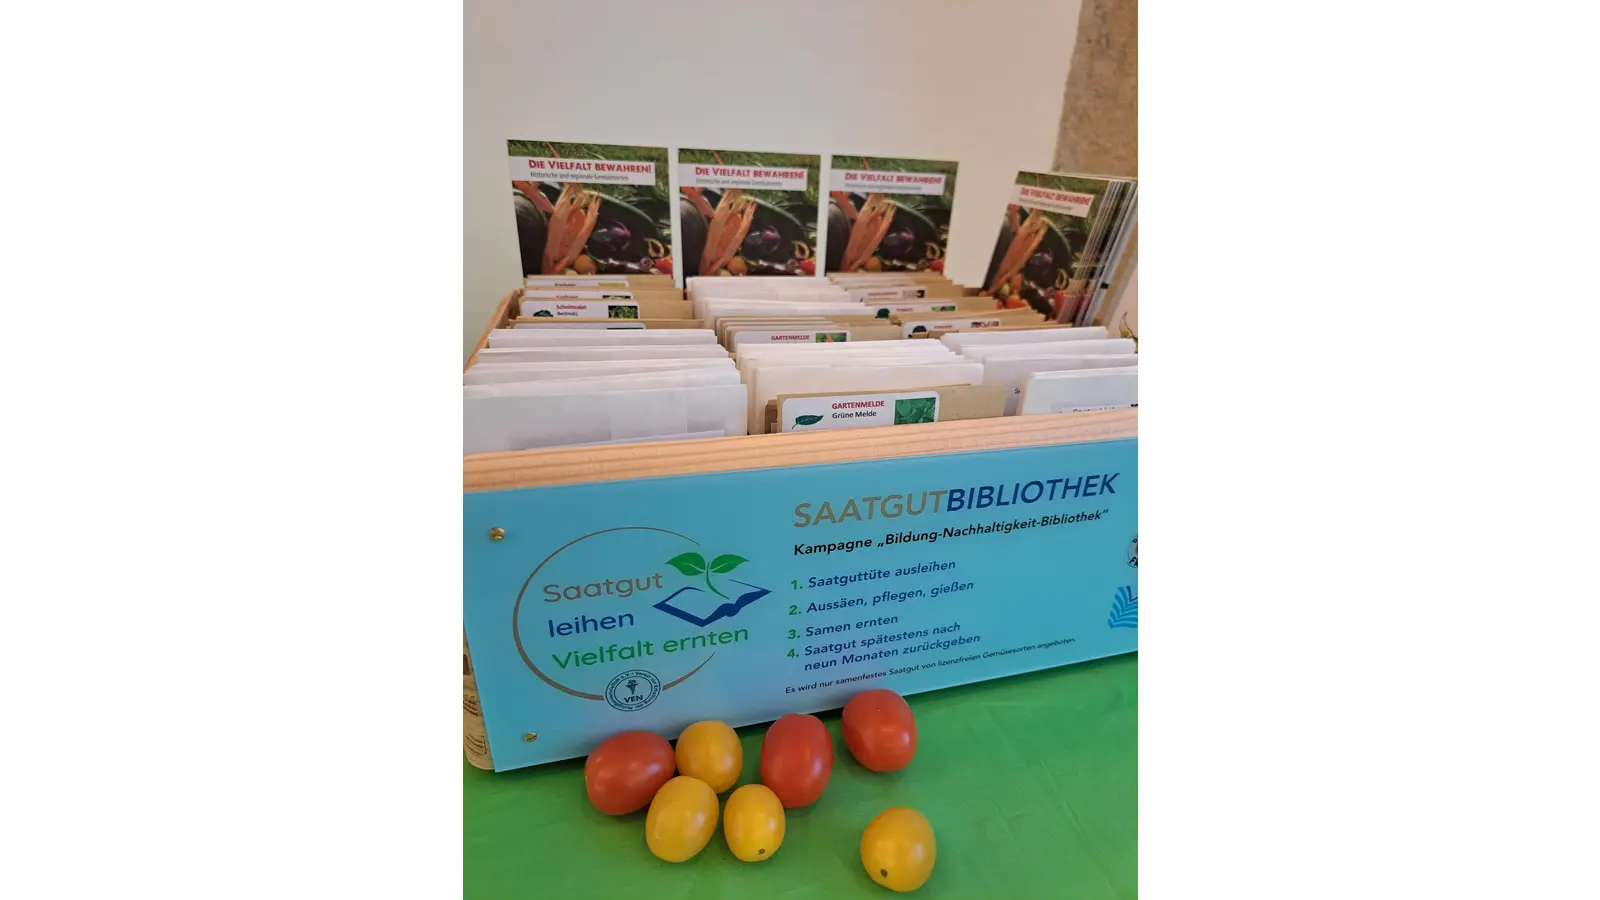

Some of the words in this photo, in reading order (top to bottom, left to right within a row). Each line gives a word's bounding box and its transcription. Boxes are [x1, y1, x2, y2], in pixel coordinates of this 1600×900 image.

[528, 159, 545, 169] DIE
[548, 160, 592, 171] VIELFALT
[595, 163, 652, 174] BEWAHREN!
[695, 166, 709, 176] DIE
[712, 167, 751, 177] VIELFALT
[753, 169, 805, 180] BEWAHREN!
[831, 400, 885, 410] GARTENMELDE
[831, 411, 854, 420] Grüne
[854, 410, 877, 418] Melde
[793, 472, 1120, 528] SAATGUTBIBLIOTHEK
[794, 538, 873, 555] Kampagne
[543, 572, 663, 603] Saatgut
[790, 579, 804, 590] 1.
[808, 569, 891, 588] Saatguttüte
[894, 560, 956, 577] ausleihen
[788, 604, 802, 616] 2.
[806, 597, 868, 614] Aussäen,
[872, 589, 926, 606] pflegen,
[930, 581, 974, 598] gießen
[548, 611, 635, 638] leihen
[787, 628, 801, 640] 3.
[805, 622, 851, 637] Samen
[855, 615, 899, 629] ernten
[551, 640, 654, 670] Vielfalt
[662, 628, 749, 653] ernten
[786, 648, 800, 659] 4.
[804, 639, 857, 656] Saatgut
[860, 628, 929, 648] spätestens
[932, 622, 961, 635] nach
[804, 659, 837, 671] neun
[841, 648, 899, 666] Monaten
[902, 634, 981, 655] zurückgeben
[785, 686, 796, 694] Es
[797, 682, 817, 692] wird
[819, 680, 834, 688] nur
[835, 671, 887, 685] samenfestes
[888, 664, 920, 676] Saatgut
[938, 654, 981, 667] lizenzfreien
[982, 644, 1036, 659] Gemüsesorten
[623, 694, 644, 703] VEN
